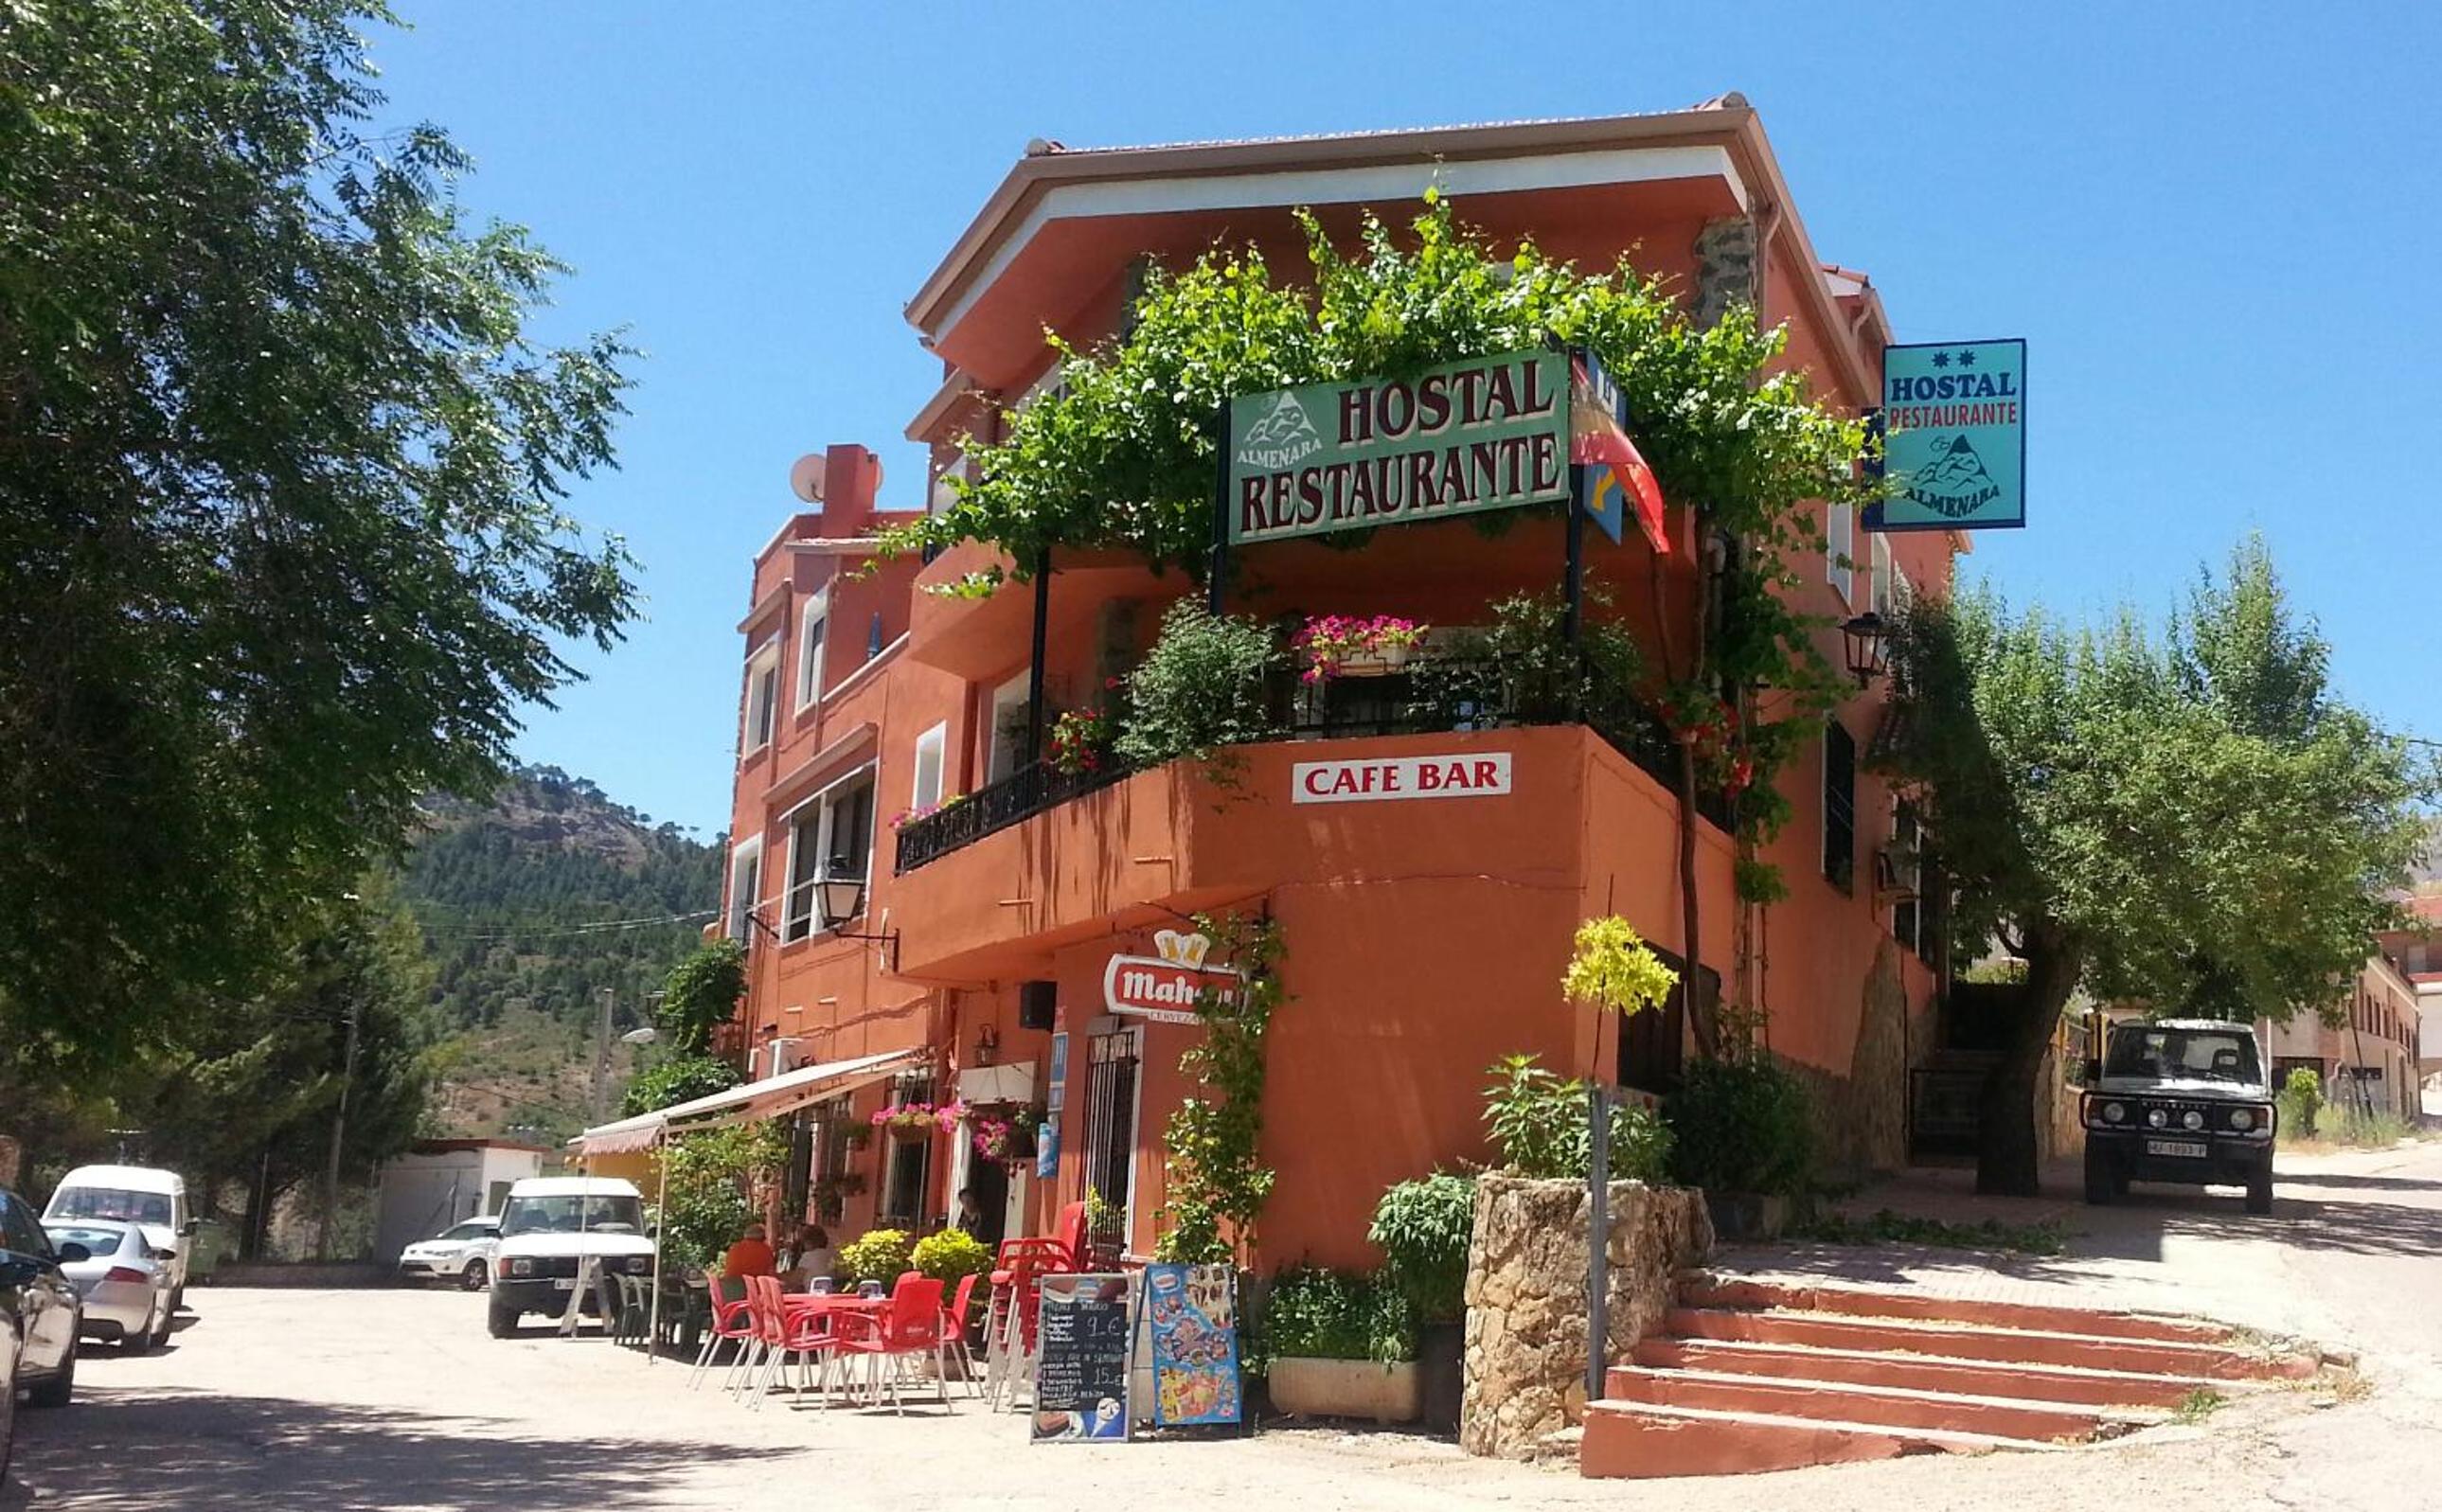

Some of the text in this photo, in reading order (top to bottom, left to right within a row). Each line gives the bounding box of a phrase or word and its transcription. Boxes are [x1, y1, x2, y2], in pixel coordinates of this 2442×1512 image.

[1338, 359, 1558, 447] HOSTAL
[1891, 372, 2017, 401] HOSTAL
[1889, 402, 2018, 429] RESTAURANTE
[1237, 438, 1323, 470] ALMENARA
[1239, 432, 1562, 536] RESTAURANTE
[1903, 485, 2000, 518] ALMENARA
[1305, 761, 1499, 795] CAFE BAR
[1123, 971, 1234, 1008] Mah
